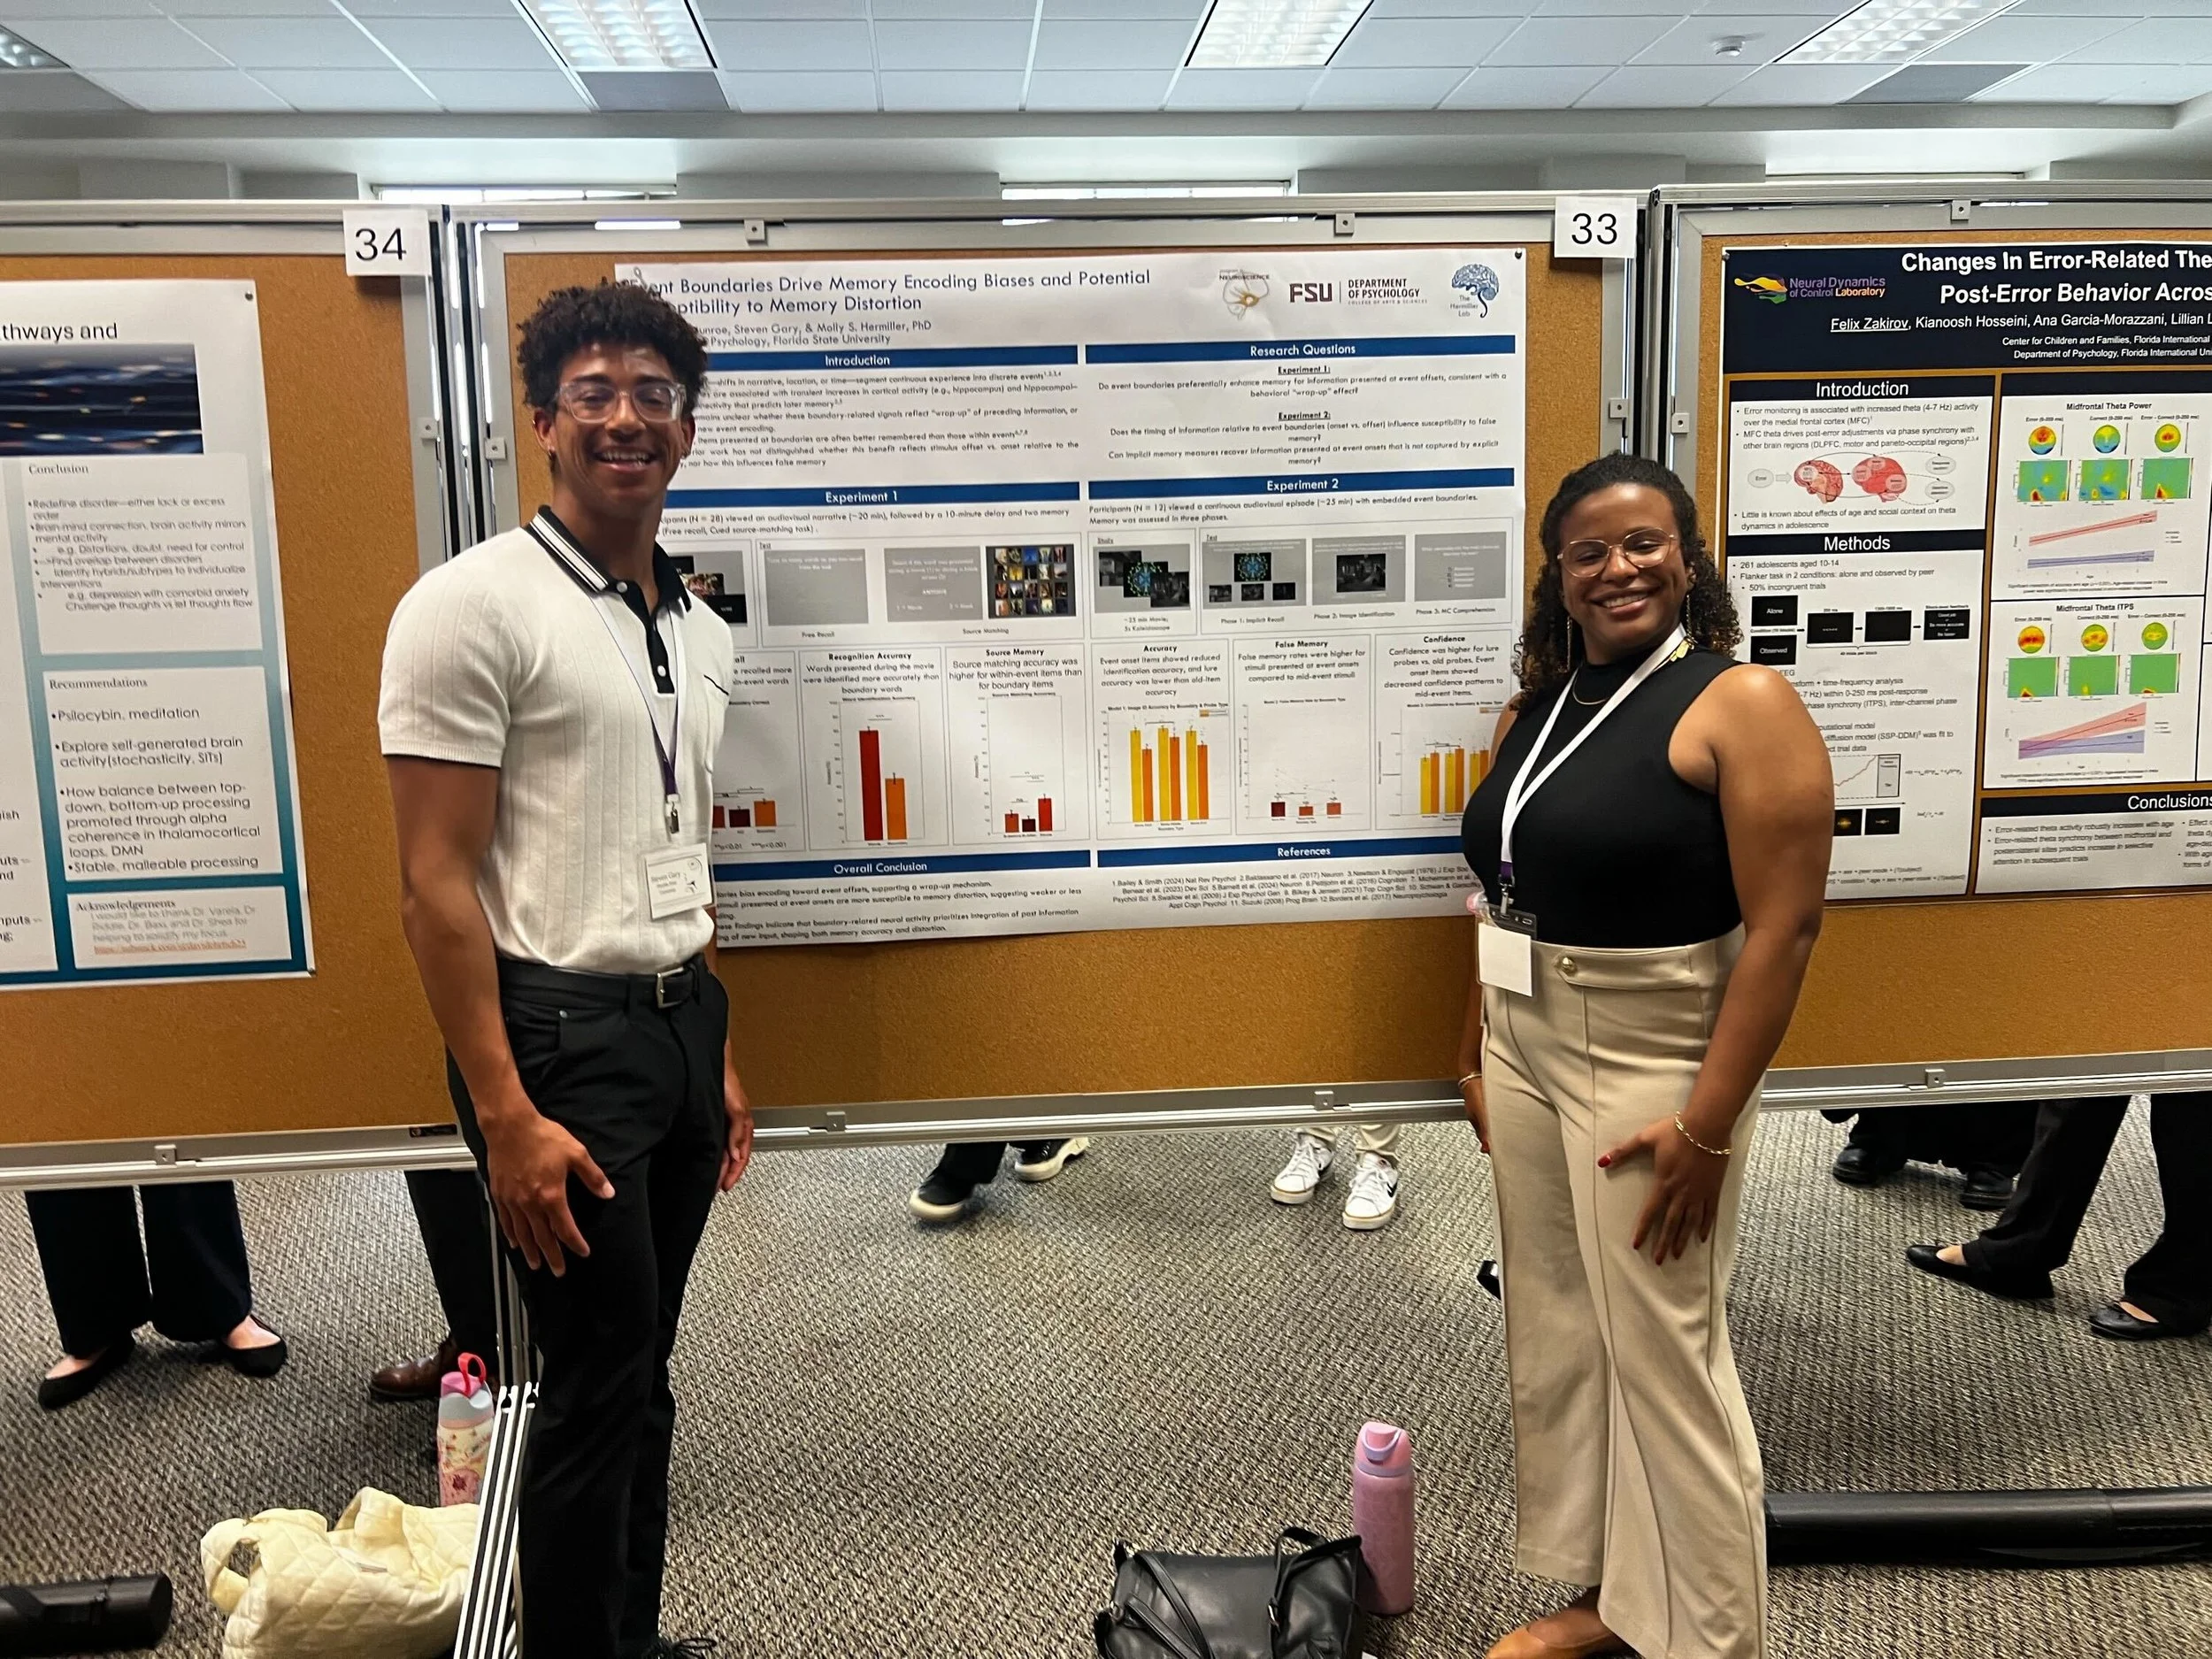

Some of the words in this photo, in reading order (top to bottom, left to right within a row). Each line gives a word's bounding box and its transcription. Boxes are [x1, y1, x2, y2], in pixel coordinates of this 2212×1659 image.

[1571, 213, 1617, 244] 33
[355, 227, 407, 261] 34
[1901, 252, 1996, 275] Changes
[2002, 251, 2022, 269] In
[2029, 250, 2168, 269] Error-Related
[2175, 250, 2212, 268] The
[681, 277, 772, 293] Boundaries
[780, 276, 821, 290] Drive
[829, 276, 896, 293] Memory
[904, 273, 976, 291] Encoding
[985, 273, 1033, 287] Biases
[1041, 272, 1071, 285] and
[1079, 269, 1148, 284] Potential
[1348, 279, 1406, 288] DEPARTMENT
[1790, 277, 1825, 288] Neural
[1828, 276, 1885, 288] Dynamics
[1289, 283, 1332, 302] FSU
[1348, 289, 1358, 298] OF
[1362, 288, 1419, 297] PSYCHOLOGY
[1835, 288, 1885, 297] Laboratory
[1940, 284, 2051, 303] Post-Error
[2057, 283, 2151, 301] Behavior
[677, 298, 739, 318] ptibility
[748, 300, 763, 312] to
[770, 297, 836, 316] Memory
[845, 295, 920, 310] Distortion
[699, 327, 730, 337] unroe,
[734, 324, 767, 334] Steven
[772, 323, 801, 335] Gary,
[817, 322, 843, 334] Molly
[861, 321, 908, 333] Hermiller,
[912, 319, 931, 330] PhD
[1831, 318, 1860, 331] Felix
[1863, 317, 1910, 331] Zakirov,
[1916, 316, 1971, 327] Kianoosh
[1976, 315, 2030, 327] Hosseini,
[2033, 314, 2056, 326] Ana
[2171, 313, 2203, 324] Lillian
[3, 323, 73, 342] thways
[81, 322, 117, 338] and
[710, 336, 769, 347] Psychology,
[773, 334, 809, 344] Florida
[812, 334, 838, 344] State
[842, 334, 890, 345] University
[1250, 344, 1299, 356] Research
[1302, 343, 1355, 354] Questions
[2014, 349, 2060, 359] Department
[2072, 349, 2118, 358] Psychology,
[2150, 345, 2197, 356] International
[826, 354, 889, 365] Introduction
[1278, 365, 1321, 374] Experiment
[1177, 380, 1226, 388] preferentially
[1816, 380, 1908, 396] Introduction
[1278, 411, 1321, 420] Experiment
[28, 464, 88, 473] Conclusion
[1267, 480, 1327, 492] Experiment
[1332, 478, 1338, 488] 2
[826, 491, 887, 504] Experiment
[893, 490, 896, 501] 1
[1824, 535, 1890, 550] Methods
[828, 652, 873, 661] Recognition
[50, 678, 147, 688] Recommendations
[128, 708, 199, 718] meditation
[61, 741, 108, 753] Explore
[112, 738, 206, 751] self-generated
[211, 736, 242, 747] brain
[66, 787, 95, 796] How
[98, 785, 153, 795] balance
[157, 783, 216, 794] between
[220, 782, 245, 794] top-
[109, 799, 178, 811] bottom-up
[182, 796, 250, 810] processing
[2128, 794, 2212, 809] Conclusions
[66, 816, 132, 829] promoted
[135, 814, 185, 826] through
[189, 812, 226, 825] alpha
[68, 831, 140, 841] coherence
[1278, 846, 1330, 856] References
[122, 858, 186, 870] malleable
[190, 856, 257, 870] processing
[833, 864, 872, 873] Overall
[876, 862, 926, 872] Conclusion
